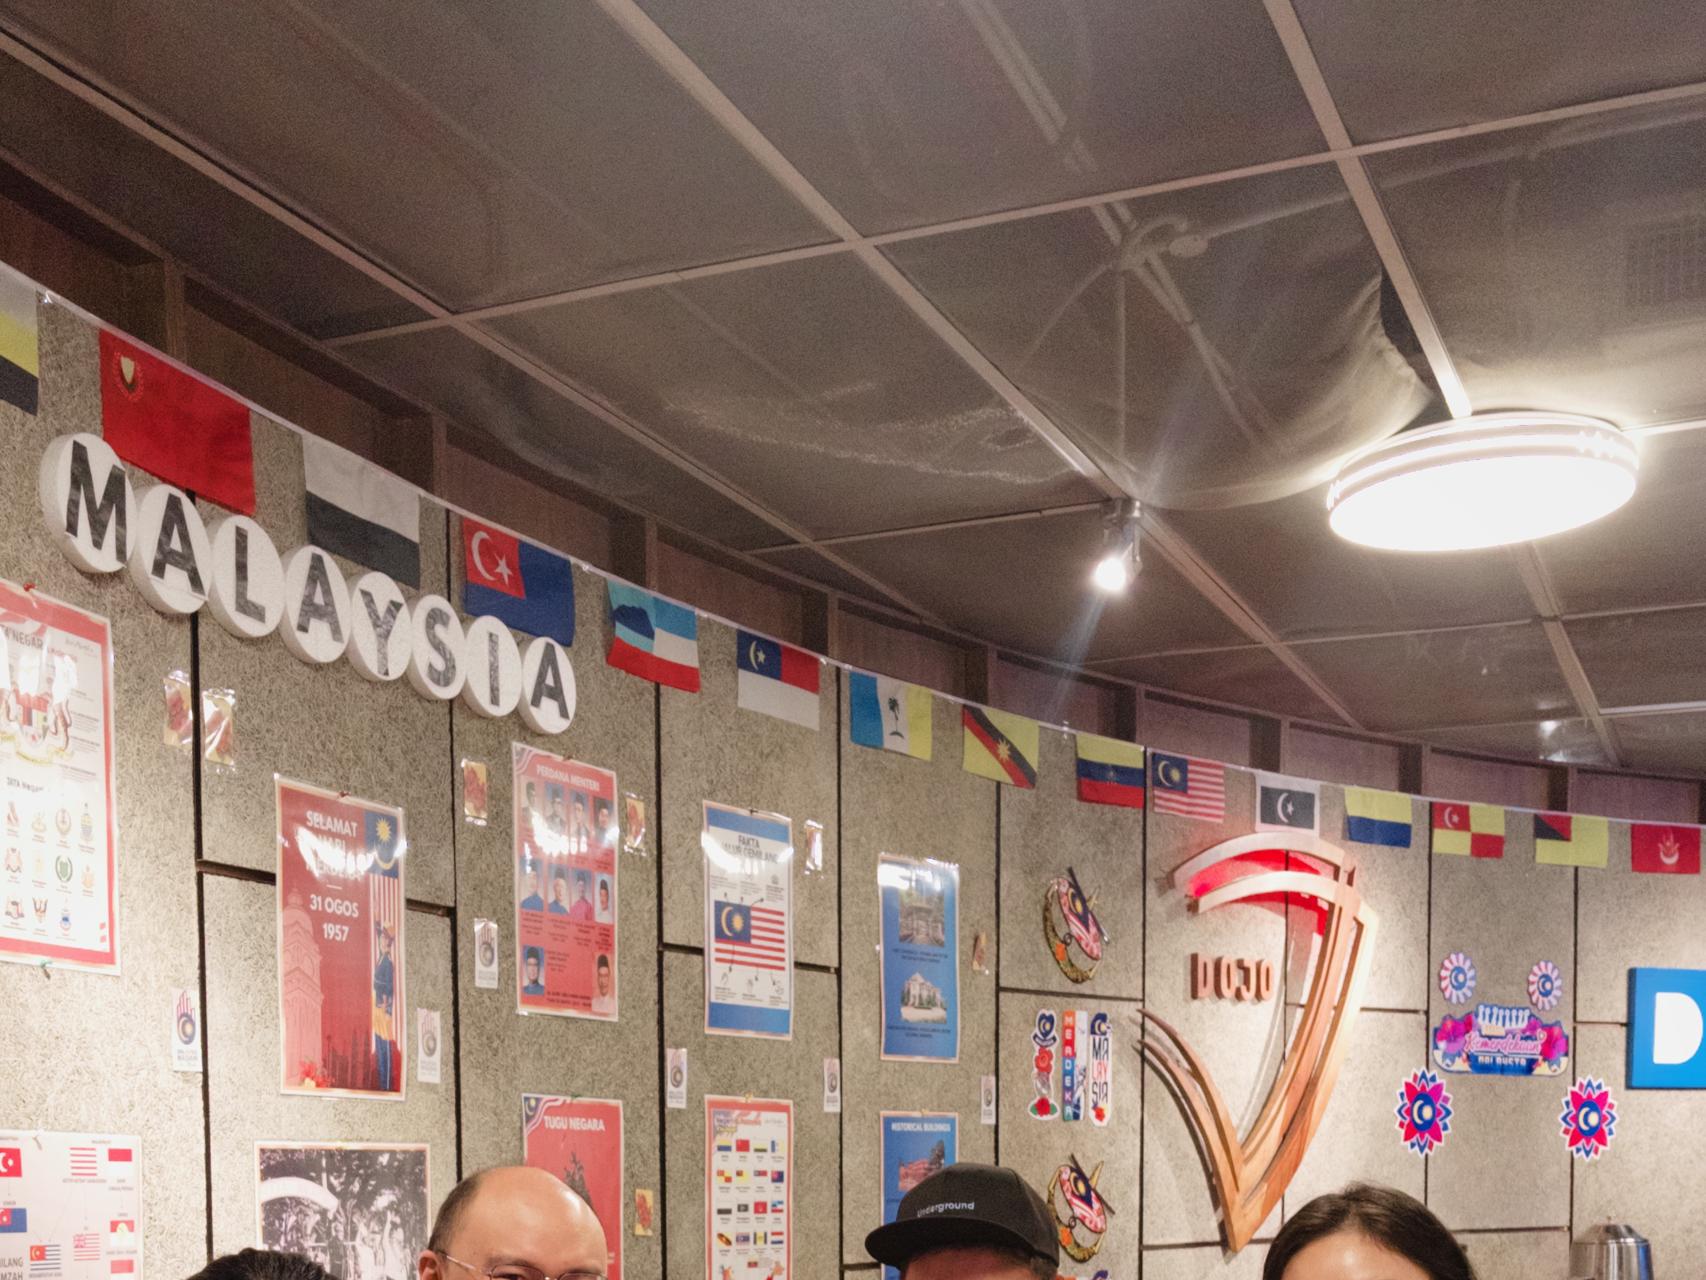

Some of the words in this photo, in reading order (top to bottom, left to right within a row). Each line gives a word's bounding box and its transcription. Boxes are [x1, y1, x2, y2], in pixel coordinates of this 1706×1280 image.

[65, 440, 570, 720] MALAYSIA
[306, 810, 358, 838] SELAMAT
[738, 834, 760, 849] FAKTA
[309, 893, 322, 912] 31
[324, 896, 359, 918] OGOS
[322, 922, 350, 942] 1957
[1193, 952, 1274, 1002] DOJO
[1652, 991, 1704, 1065] D
[1063, 1016, 1073, 1119] MERDEKA
[544, 1115, 567, 1130] TUGU
[569, 1116, 606, 1132] NEGARA
